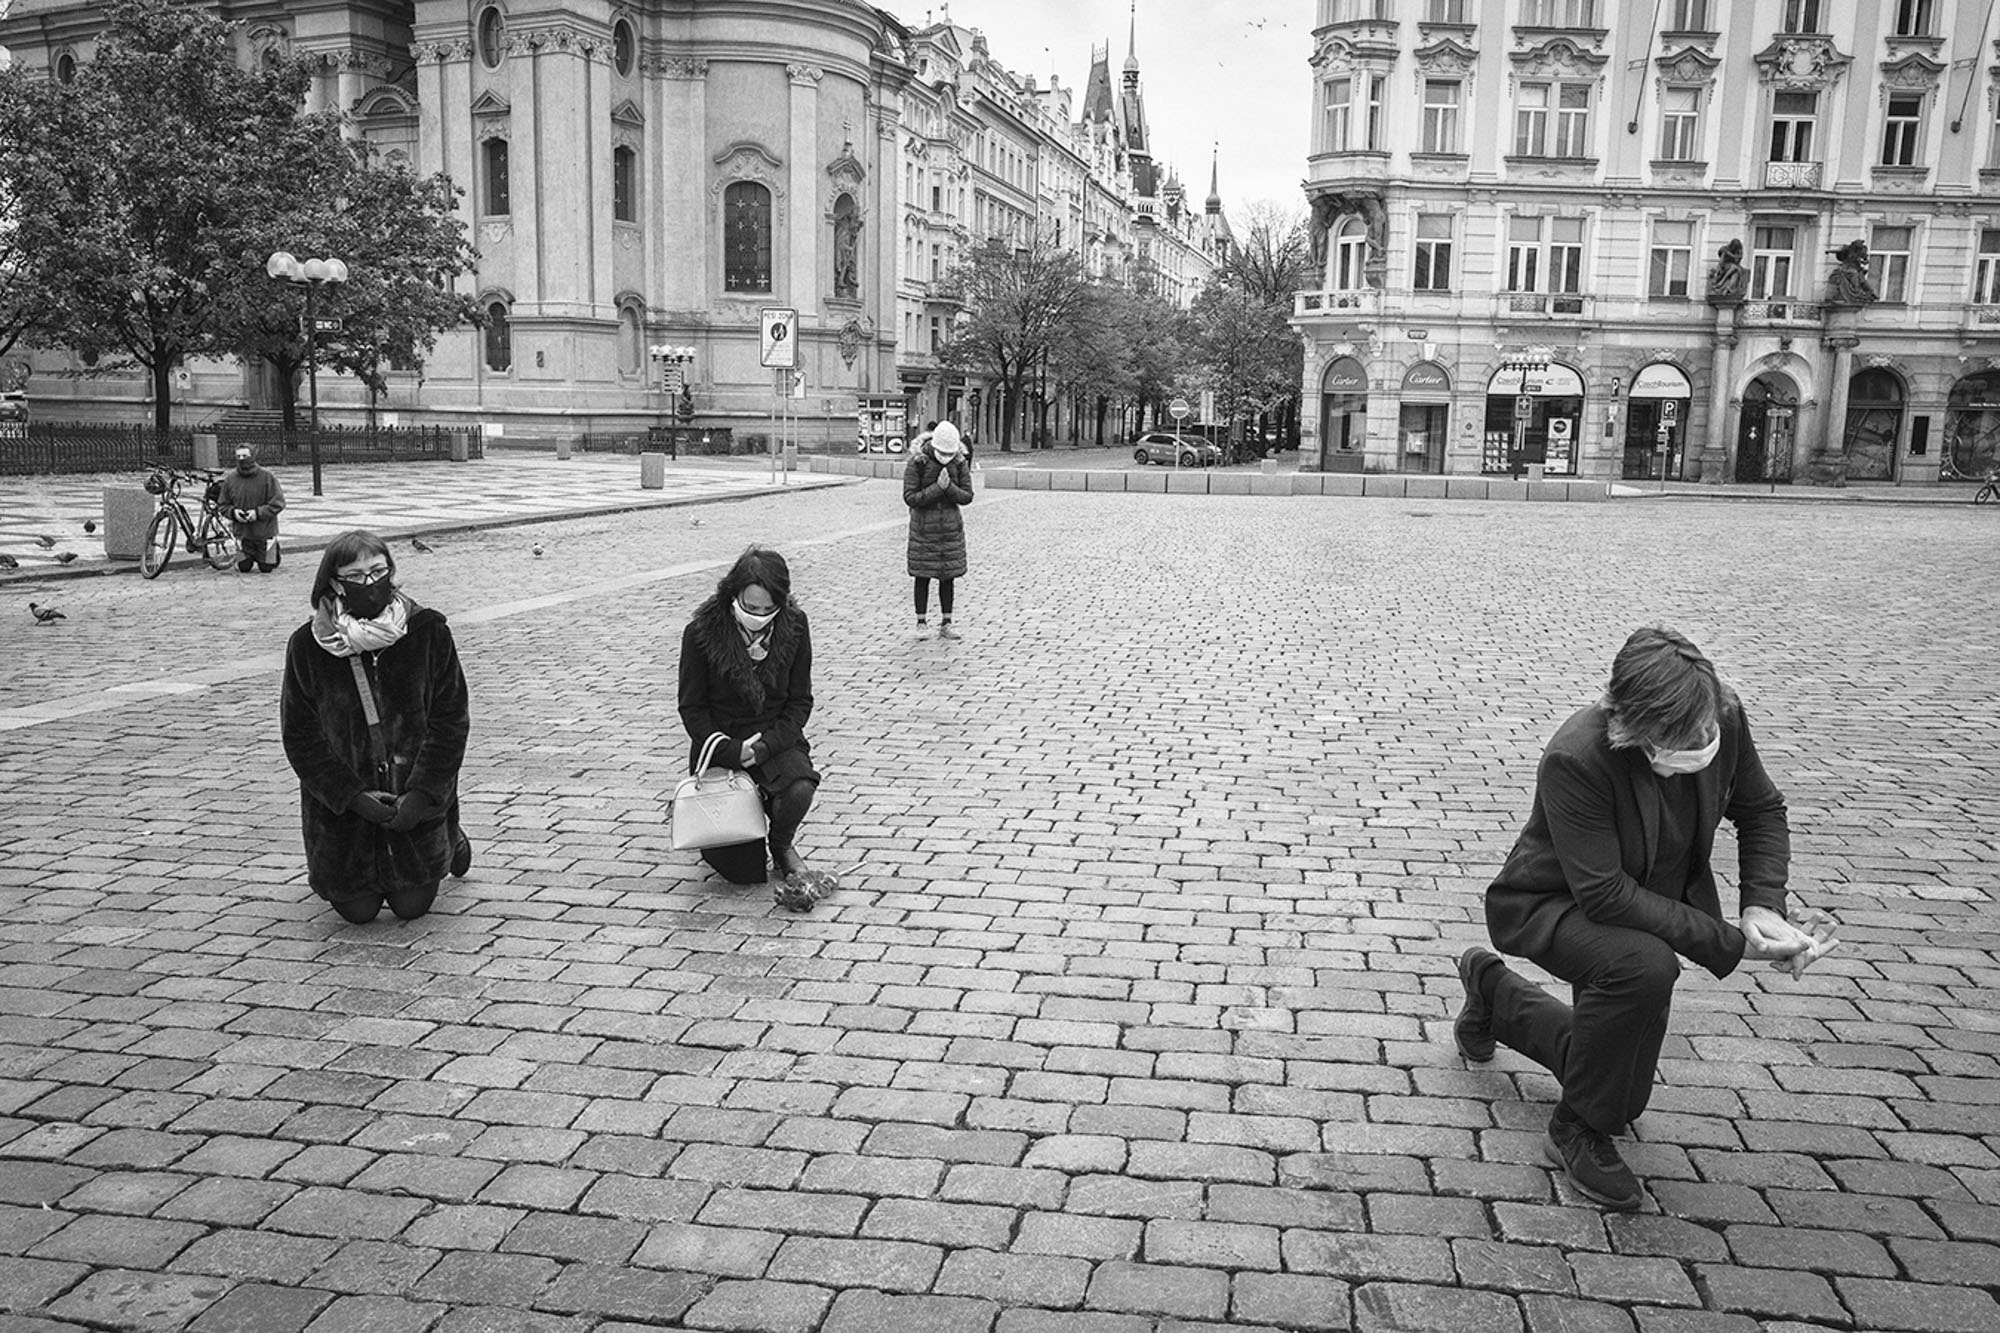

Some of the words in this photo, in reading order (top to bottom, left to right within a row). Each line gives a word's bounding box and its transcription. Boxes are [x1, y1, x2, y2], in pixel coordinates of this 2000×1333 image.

[1331, 374, 1359, 386] Cartier
[1408, 372, 1443, 385] Cartier
[1665, 402, 1675, 414] P
